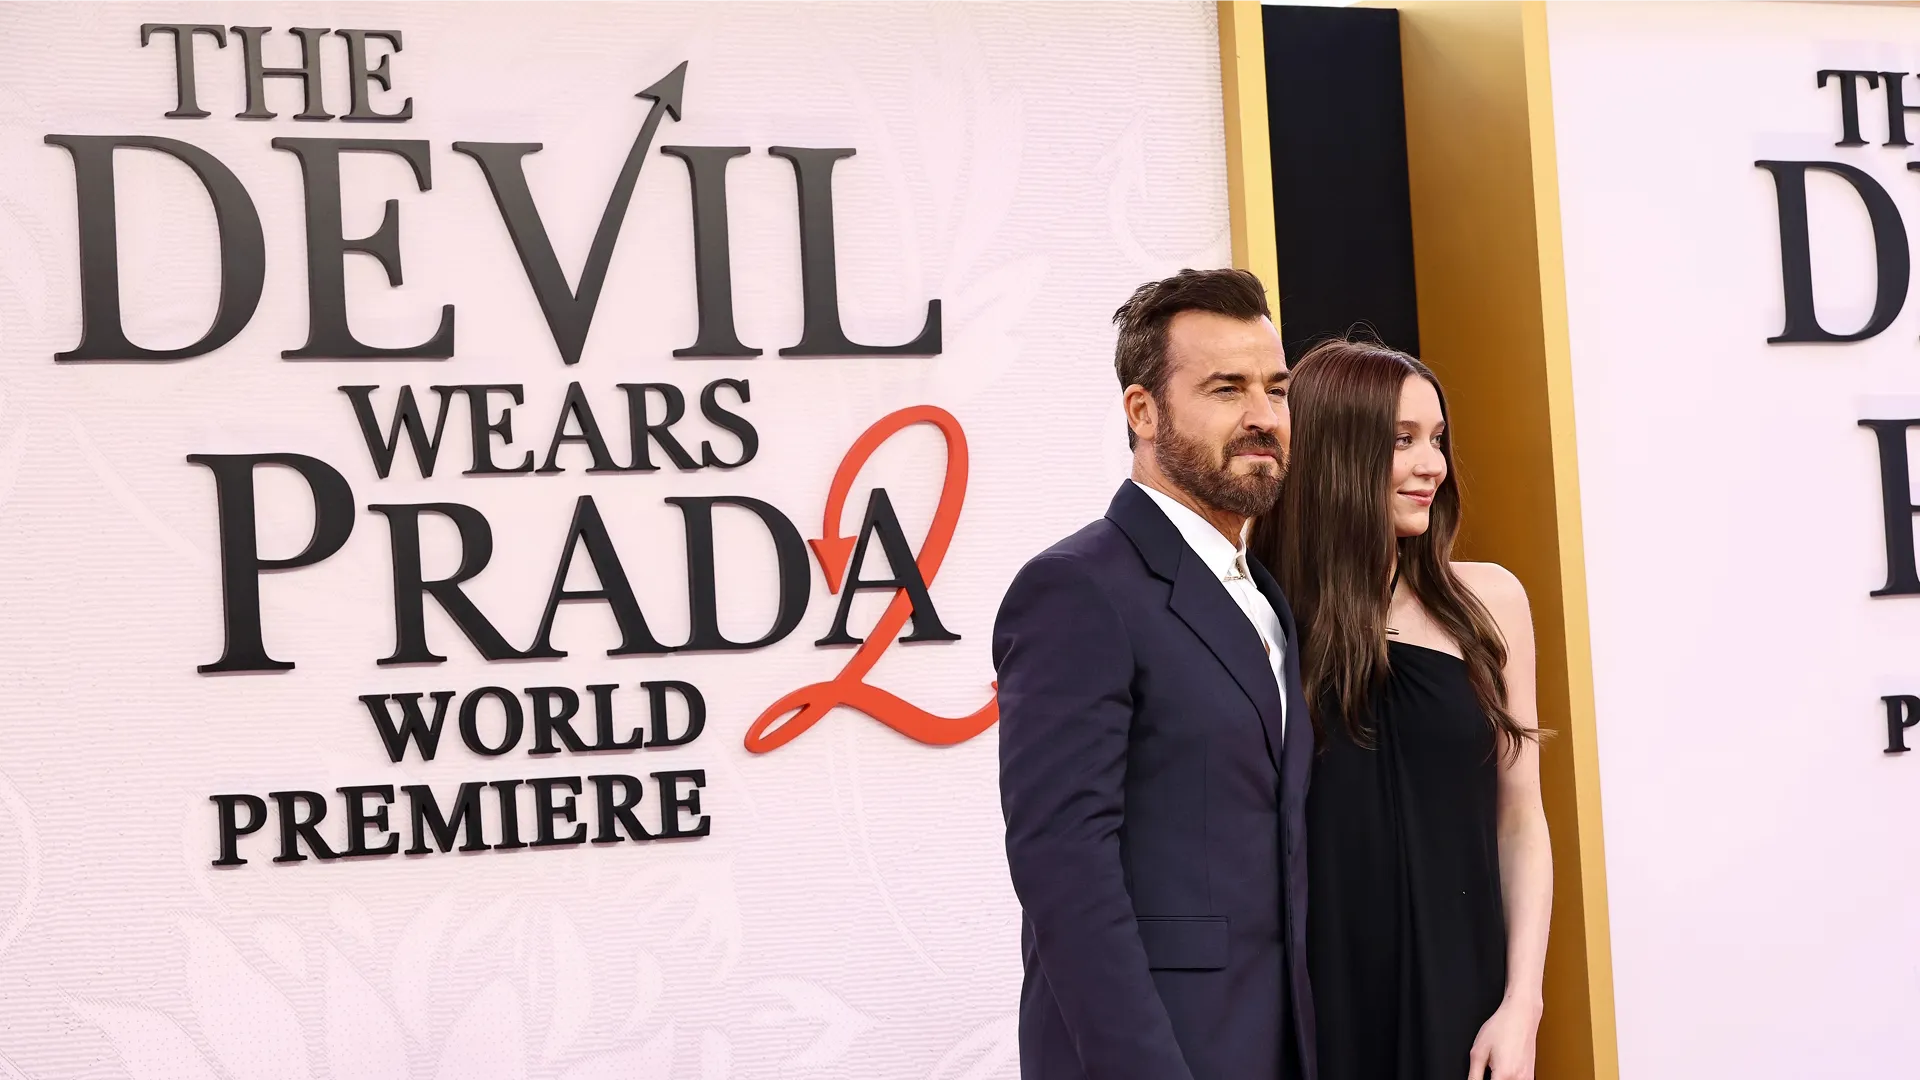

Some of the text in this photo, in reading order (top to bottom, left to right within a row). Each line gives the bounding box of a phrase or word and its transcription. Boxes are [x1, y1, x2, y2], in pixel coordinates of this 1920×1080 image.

[140, 23, 413, 121] THE
[43, 61, 943, 365] DEVIL
[1754, 159, 1920, 345] D
[338, 377, 759, 480] WEARS
[186, 452, 961, 676] PRADA
[359, 680, 707, 764] WORLD
[209, 768, 711, 868] PREMIERE
